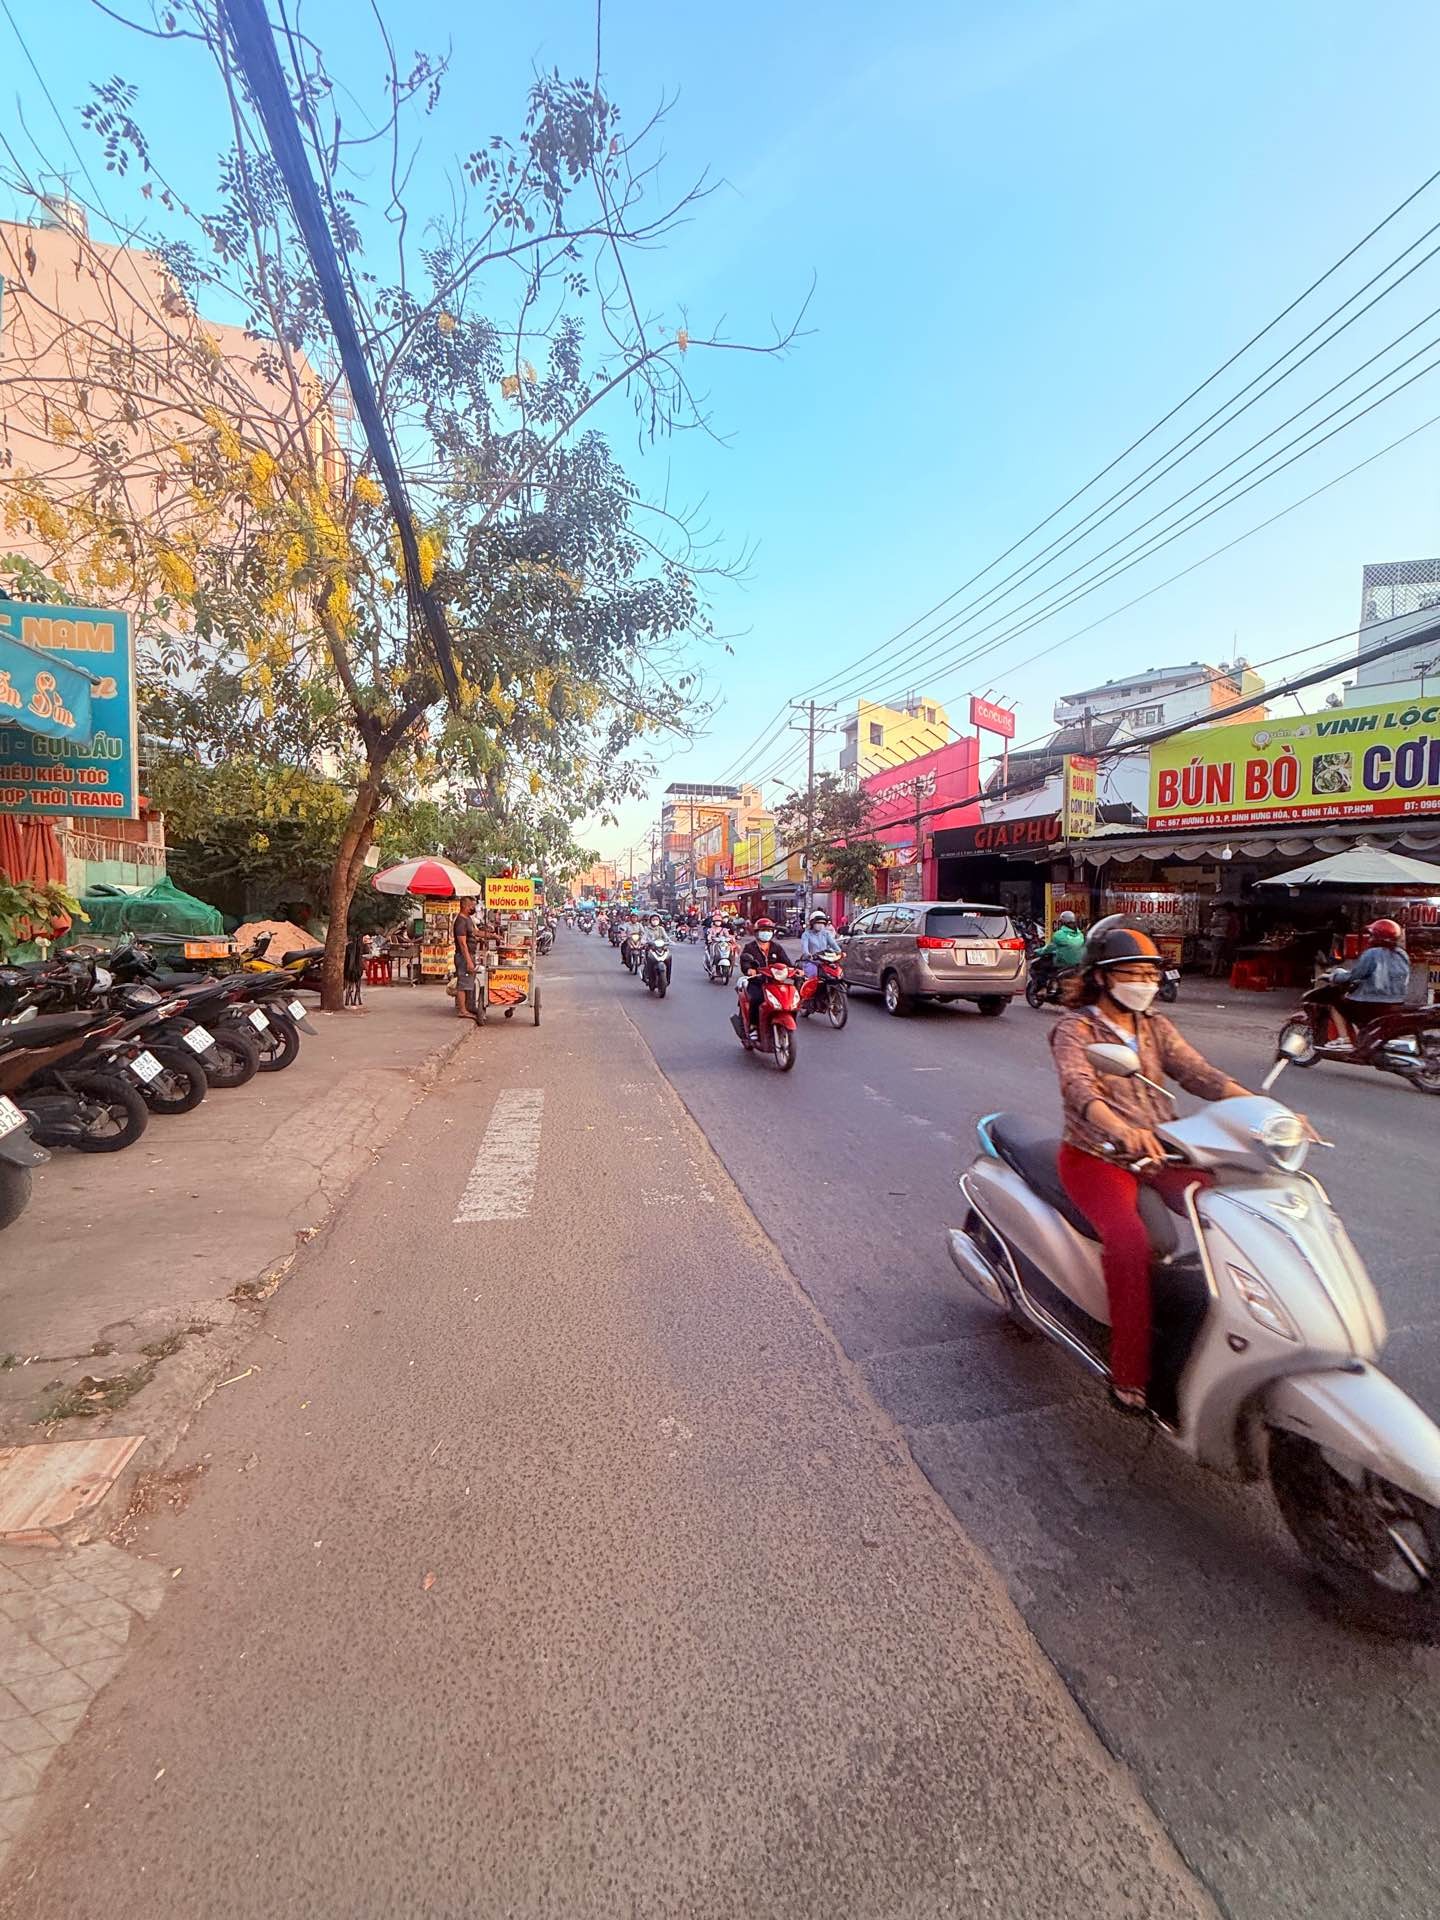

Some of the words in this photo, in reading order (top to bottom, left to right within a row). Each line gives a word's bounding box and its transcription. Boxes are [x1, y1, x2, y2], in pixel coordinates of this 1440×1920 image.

[22, 616, 115, 653] NAM
[1315, 713, 1380, 737] VINH
[76, 766, 109, 785] TÓC
[1157, 754, 1234, 811] BÚN
[1244, 744, 1301, 803] BÒ
[29, 787, 68, 807] THỜI
[70, 789, 124, 808] TRANG
